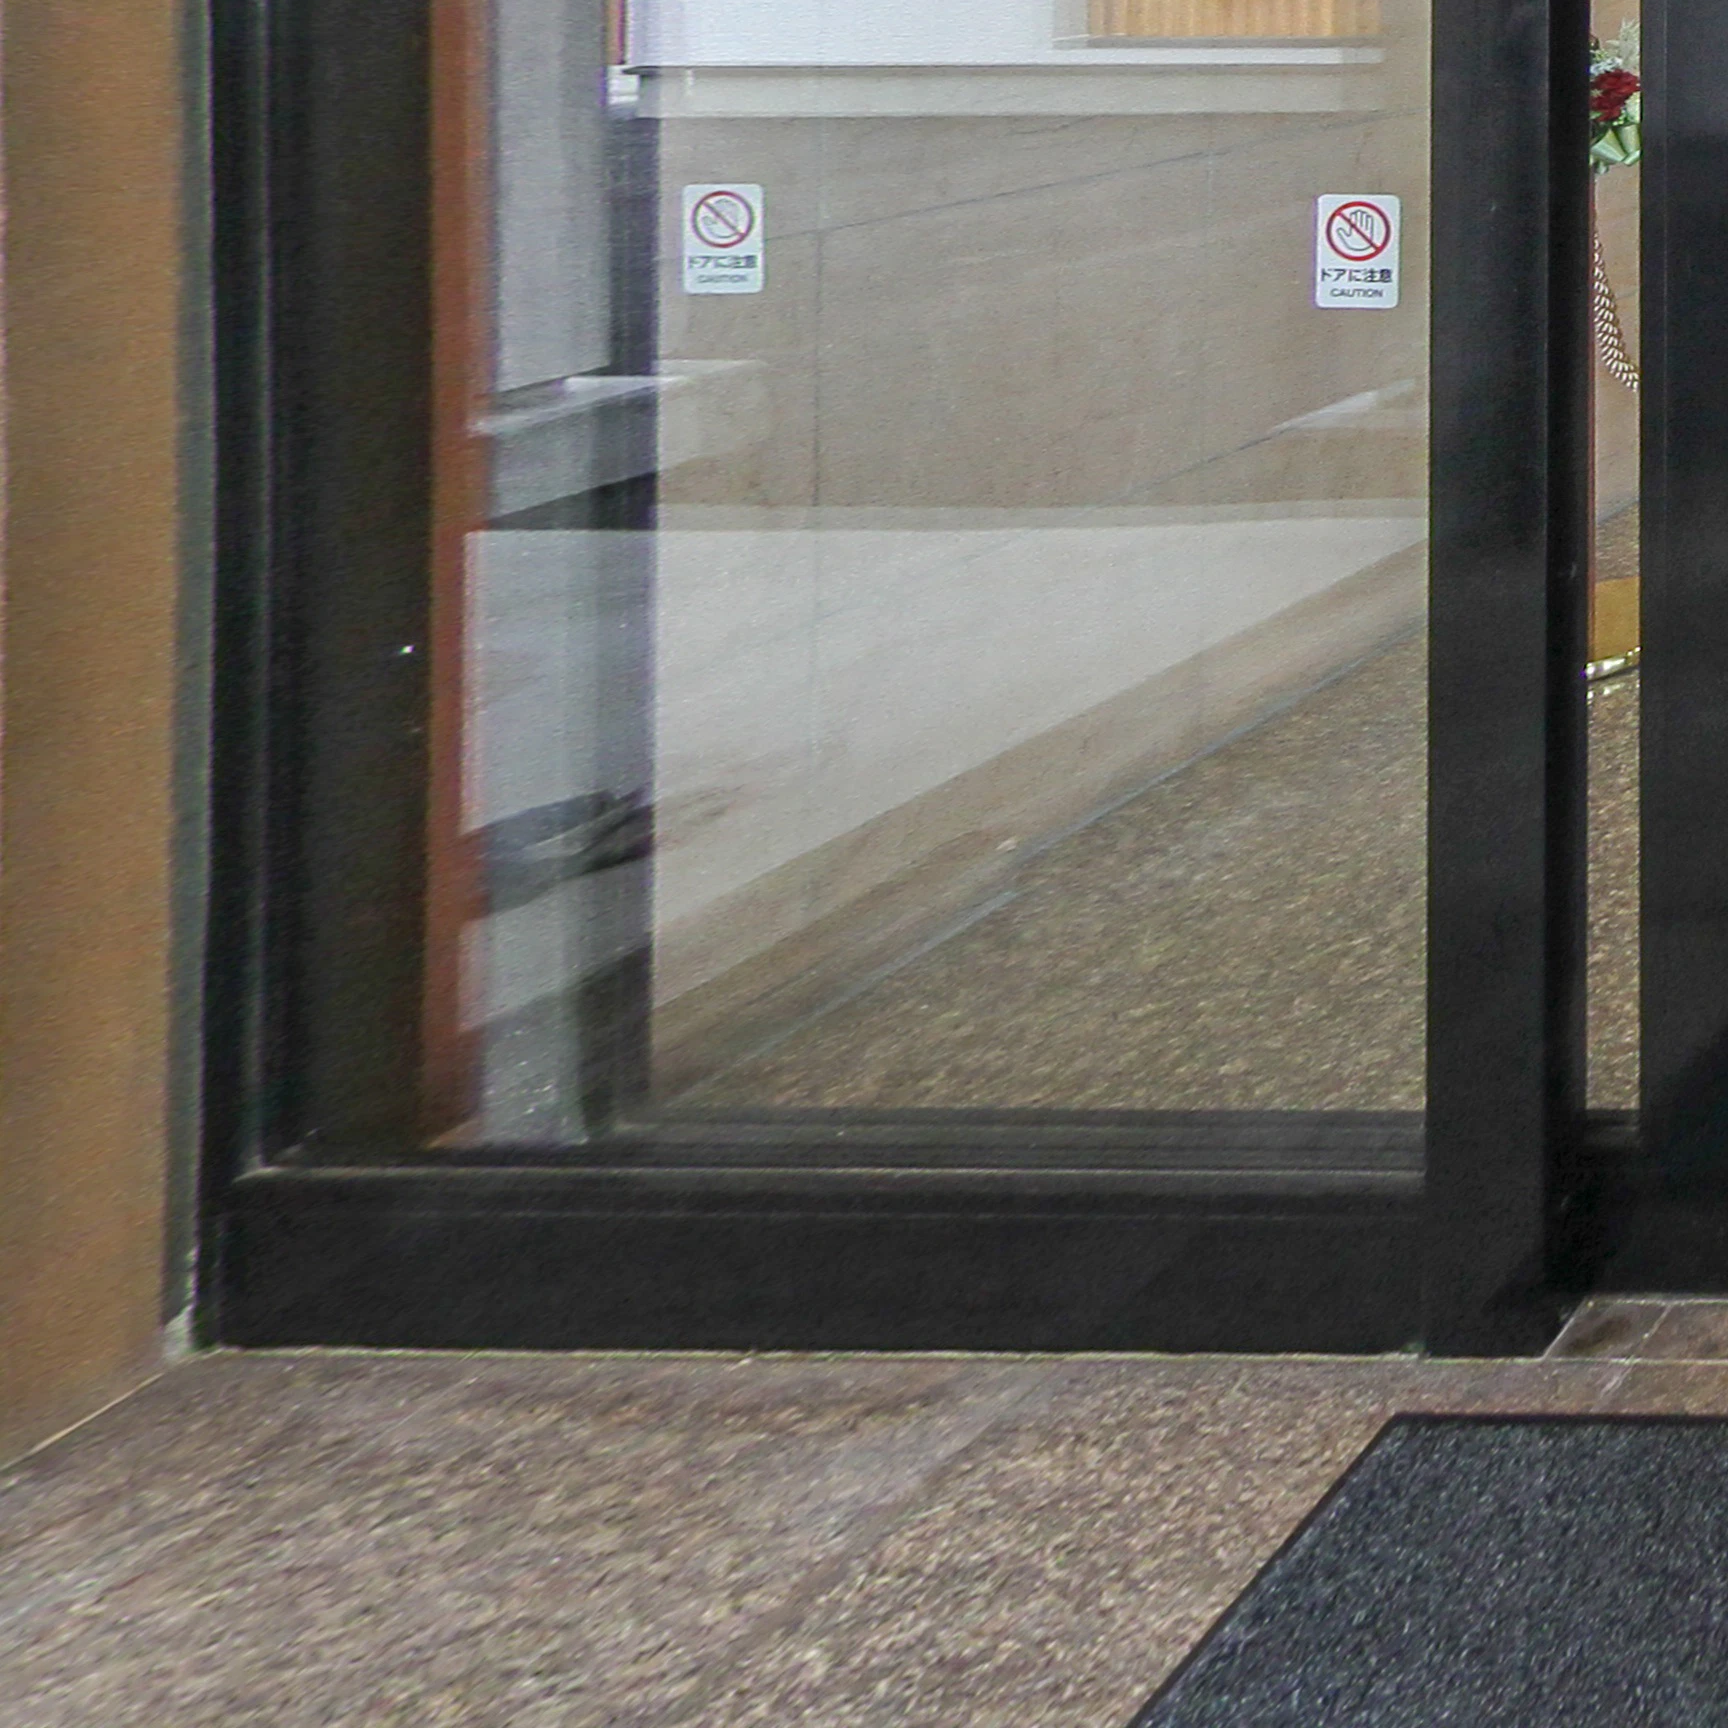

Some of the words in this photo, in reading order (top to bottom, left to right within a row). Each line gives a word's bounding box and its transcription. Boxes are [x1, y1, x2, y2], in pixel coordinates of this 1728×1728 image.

[1320, 268, 1394, 283] ドアに注意
[1330, 288, 1384, 298] CAUTION
